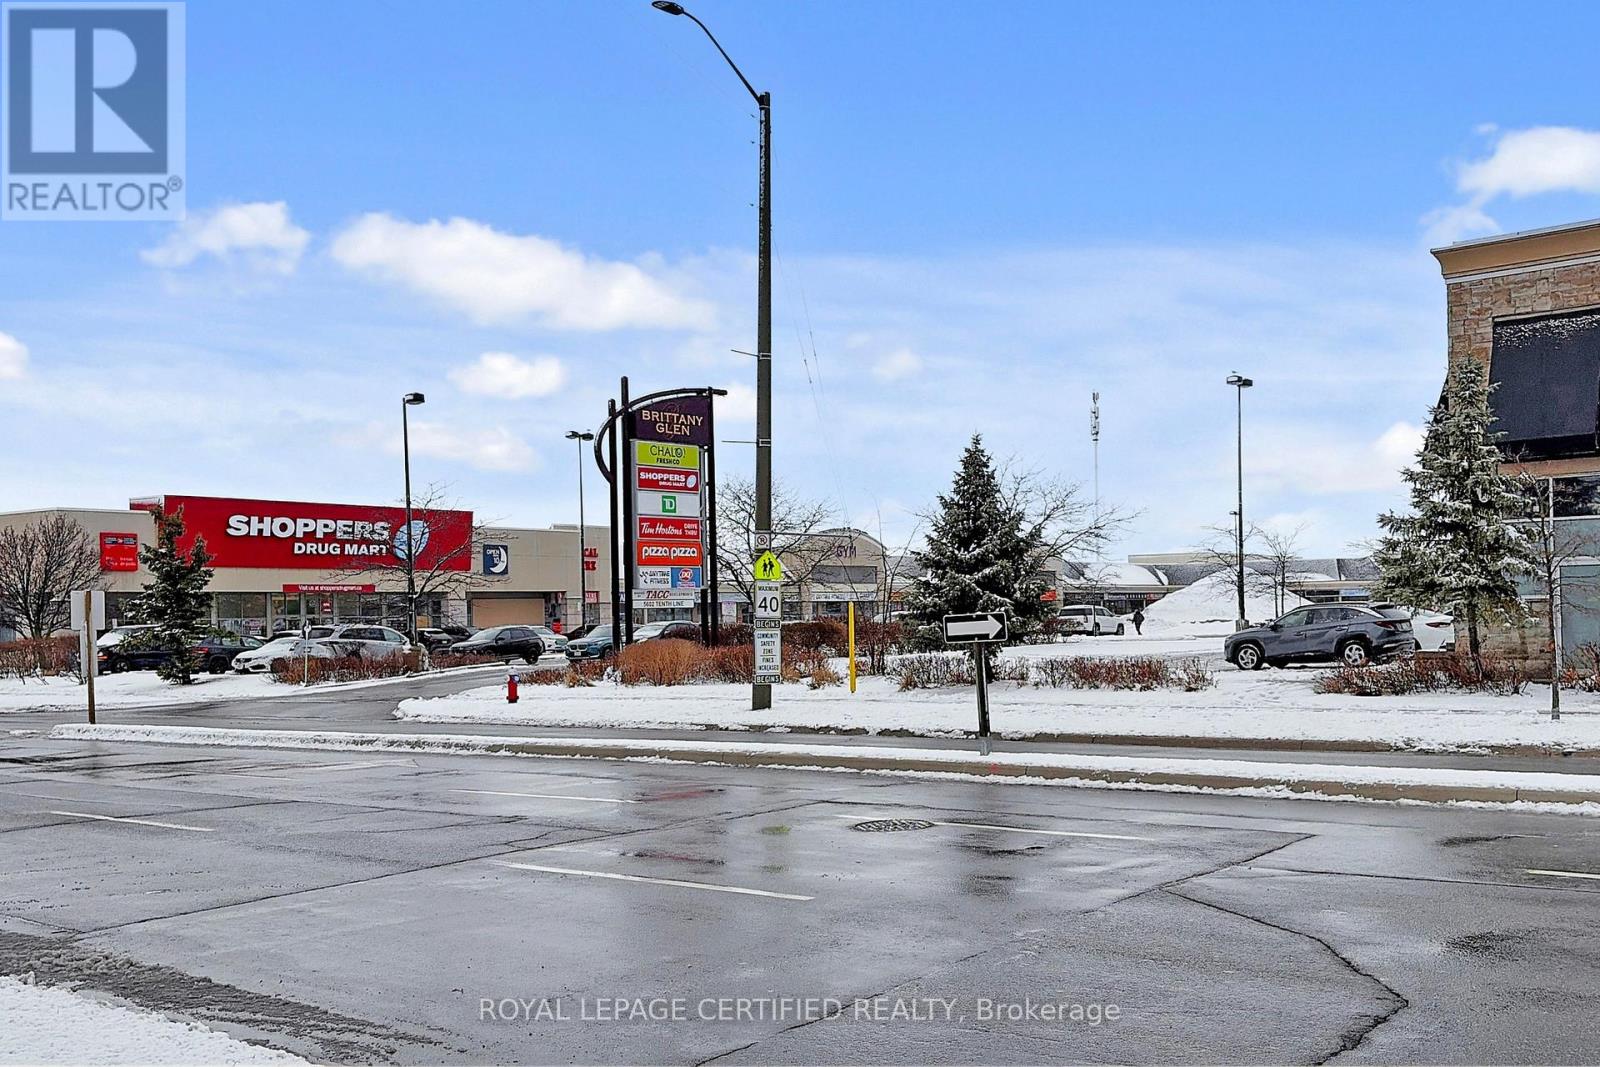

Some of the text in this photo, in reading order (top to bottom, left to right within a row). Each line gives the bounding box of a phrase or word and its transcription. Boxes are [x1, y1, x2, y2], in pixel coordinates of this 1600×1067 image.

[642, 410, 703, 426] BRITTANY
[656, 423, 690, 436] GLEN
[640, 472, 685, 482] SHOPPERS
[664, 498, 675, 510] TD
[226, 514, 391, 540] SHOPPERS
[641, 522, 682, 536] Tim Hortons
[294, 542, 389, 556] DRUG MART
[642, 546, 697, 560] pizza pizza
[646, 590, 670, 599] TACC
[758, 596, 779, 612] 40
[756, 675, 779, 683] BEGINS
